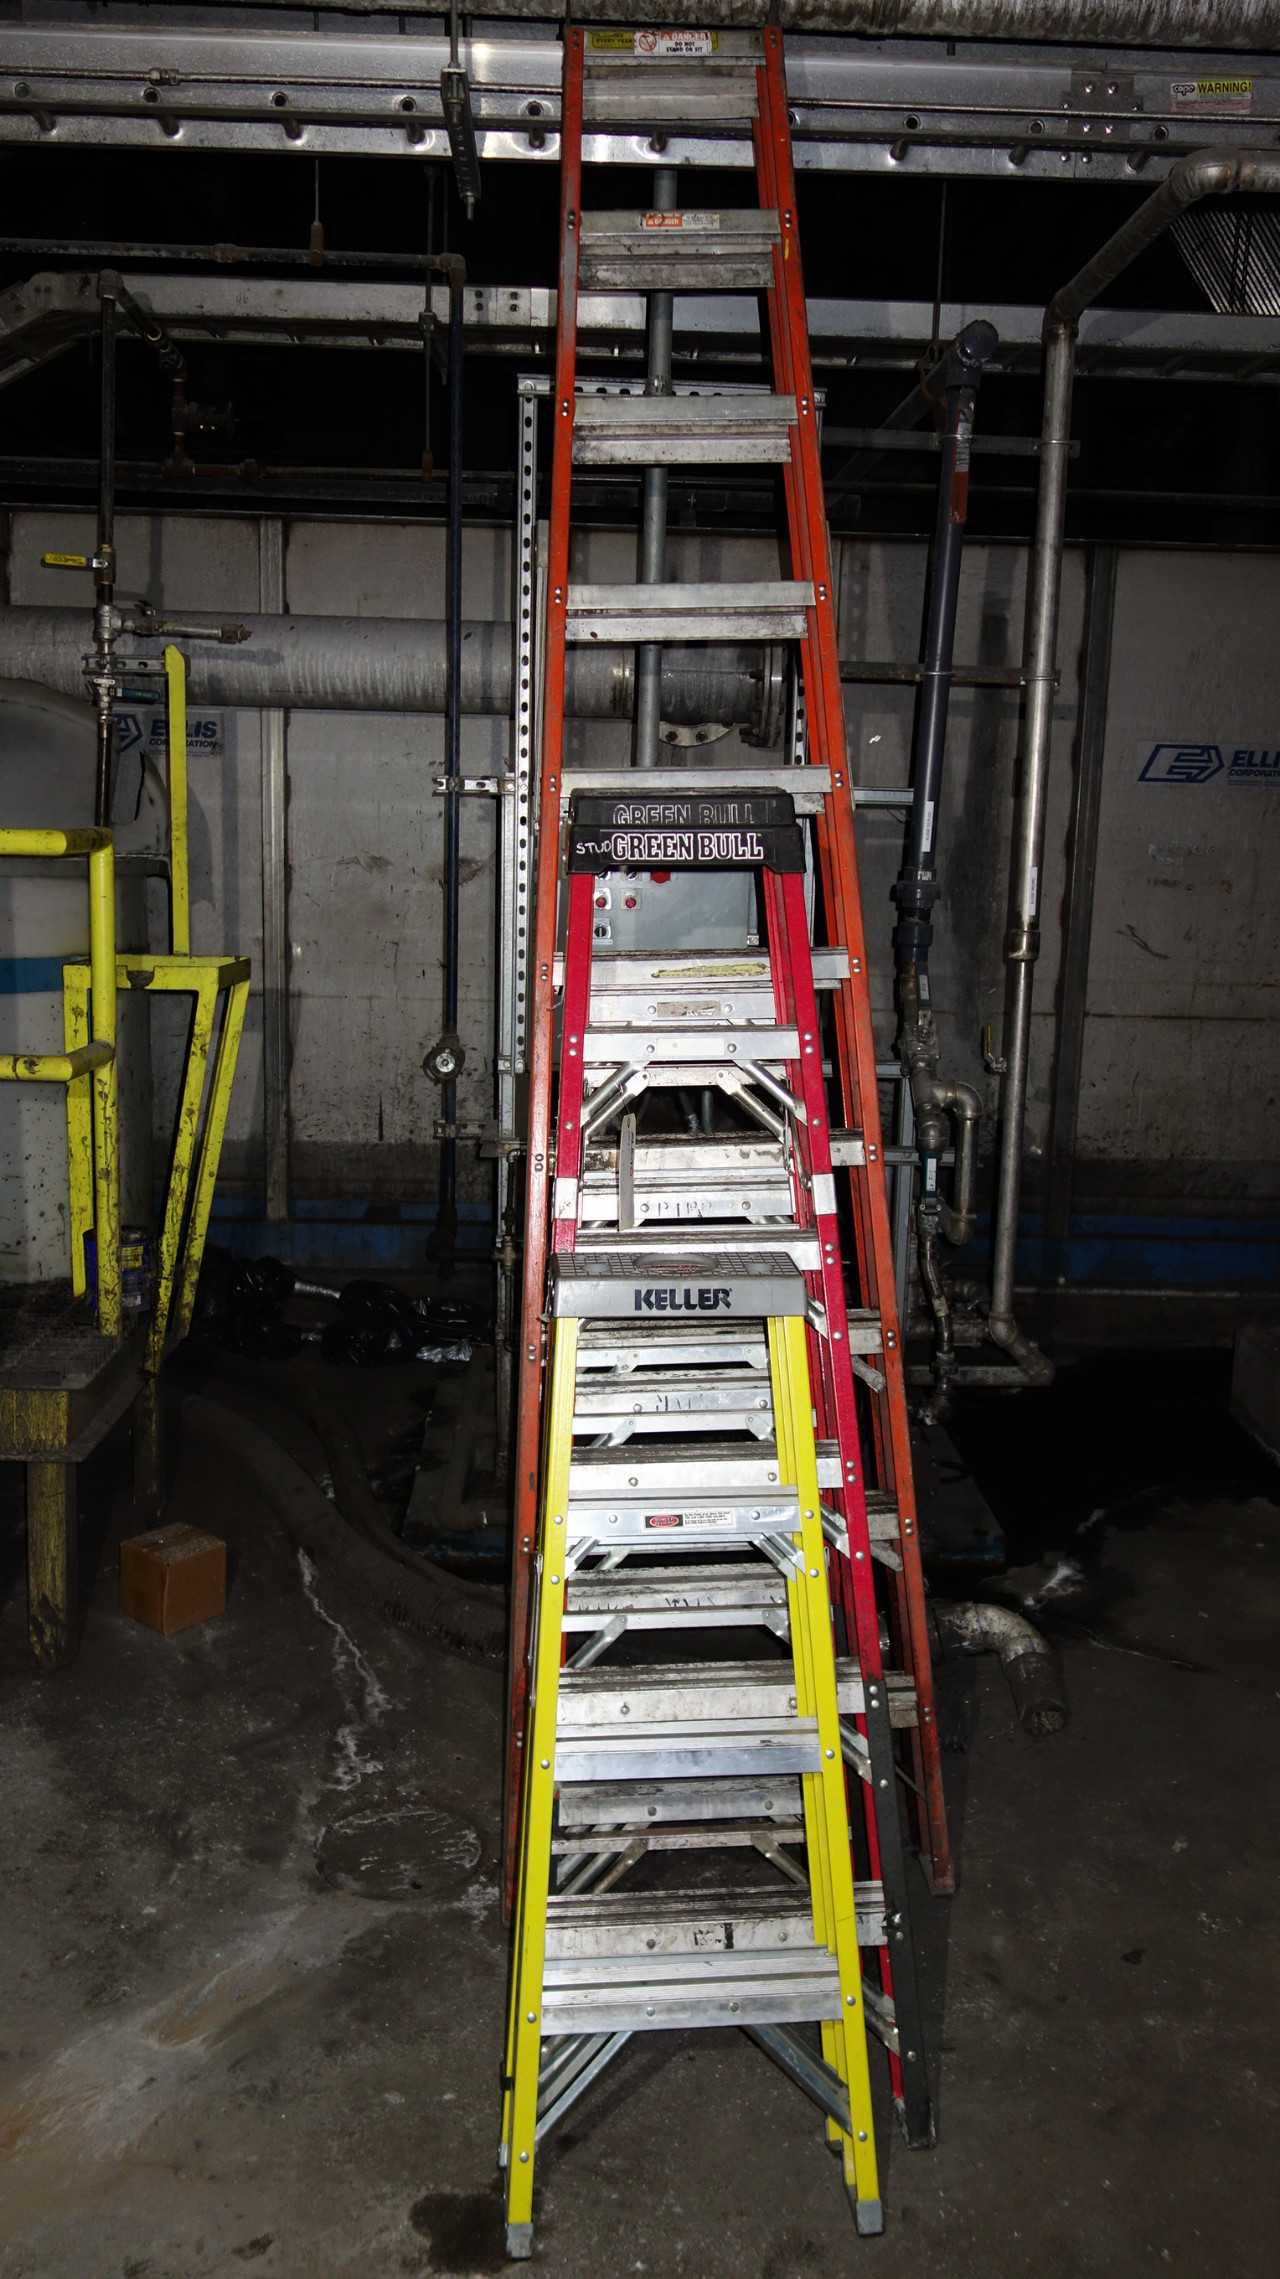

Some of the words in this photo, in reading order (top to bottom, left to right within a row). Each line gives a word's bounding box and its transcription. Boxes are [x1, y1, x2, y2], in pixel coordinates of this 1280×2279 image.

[1198, 81, 1252, 93] WARNING!
[150, 719, 217, 738] EIS
[613, 804, 691, 824] GREEN
[699, 803, 755, 824] BULL
[576, 840, 612, 855] STUD
[611, 833, 694, 860] GREEN
[697, 833, 764, 860] BULL
[634, 1288, 732, 1311] KELLER
